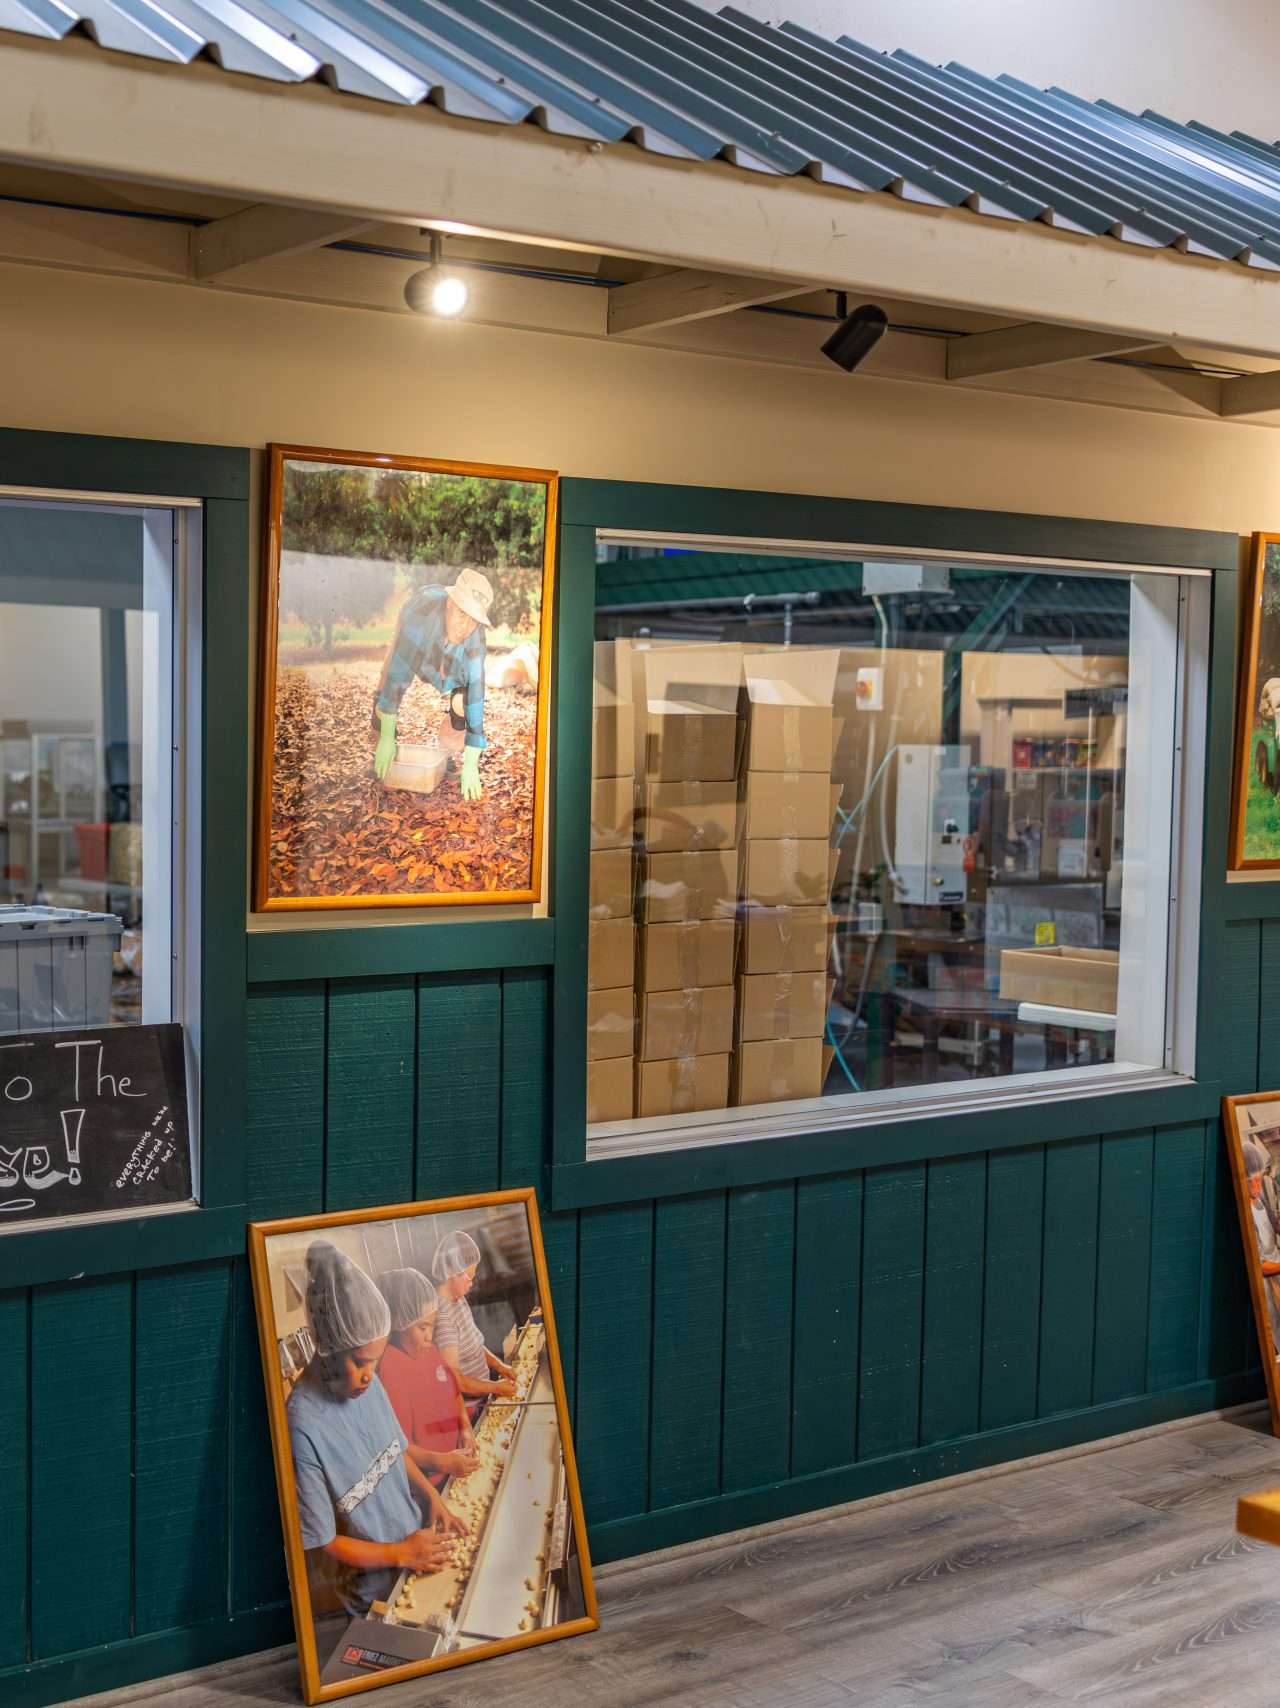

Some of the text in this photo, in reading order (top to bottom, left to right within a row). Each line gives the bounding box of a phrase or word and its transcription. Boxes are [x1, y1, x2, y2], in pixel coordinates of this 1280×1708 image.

[54, 1040, 147, 1102] The
[164, 1120, 175, 1134] up
[146, 1166, 160, 1181] To
